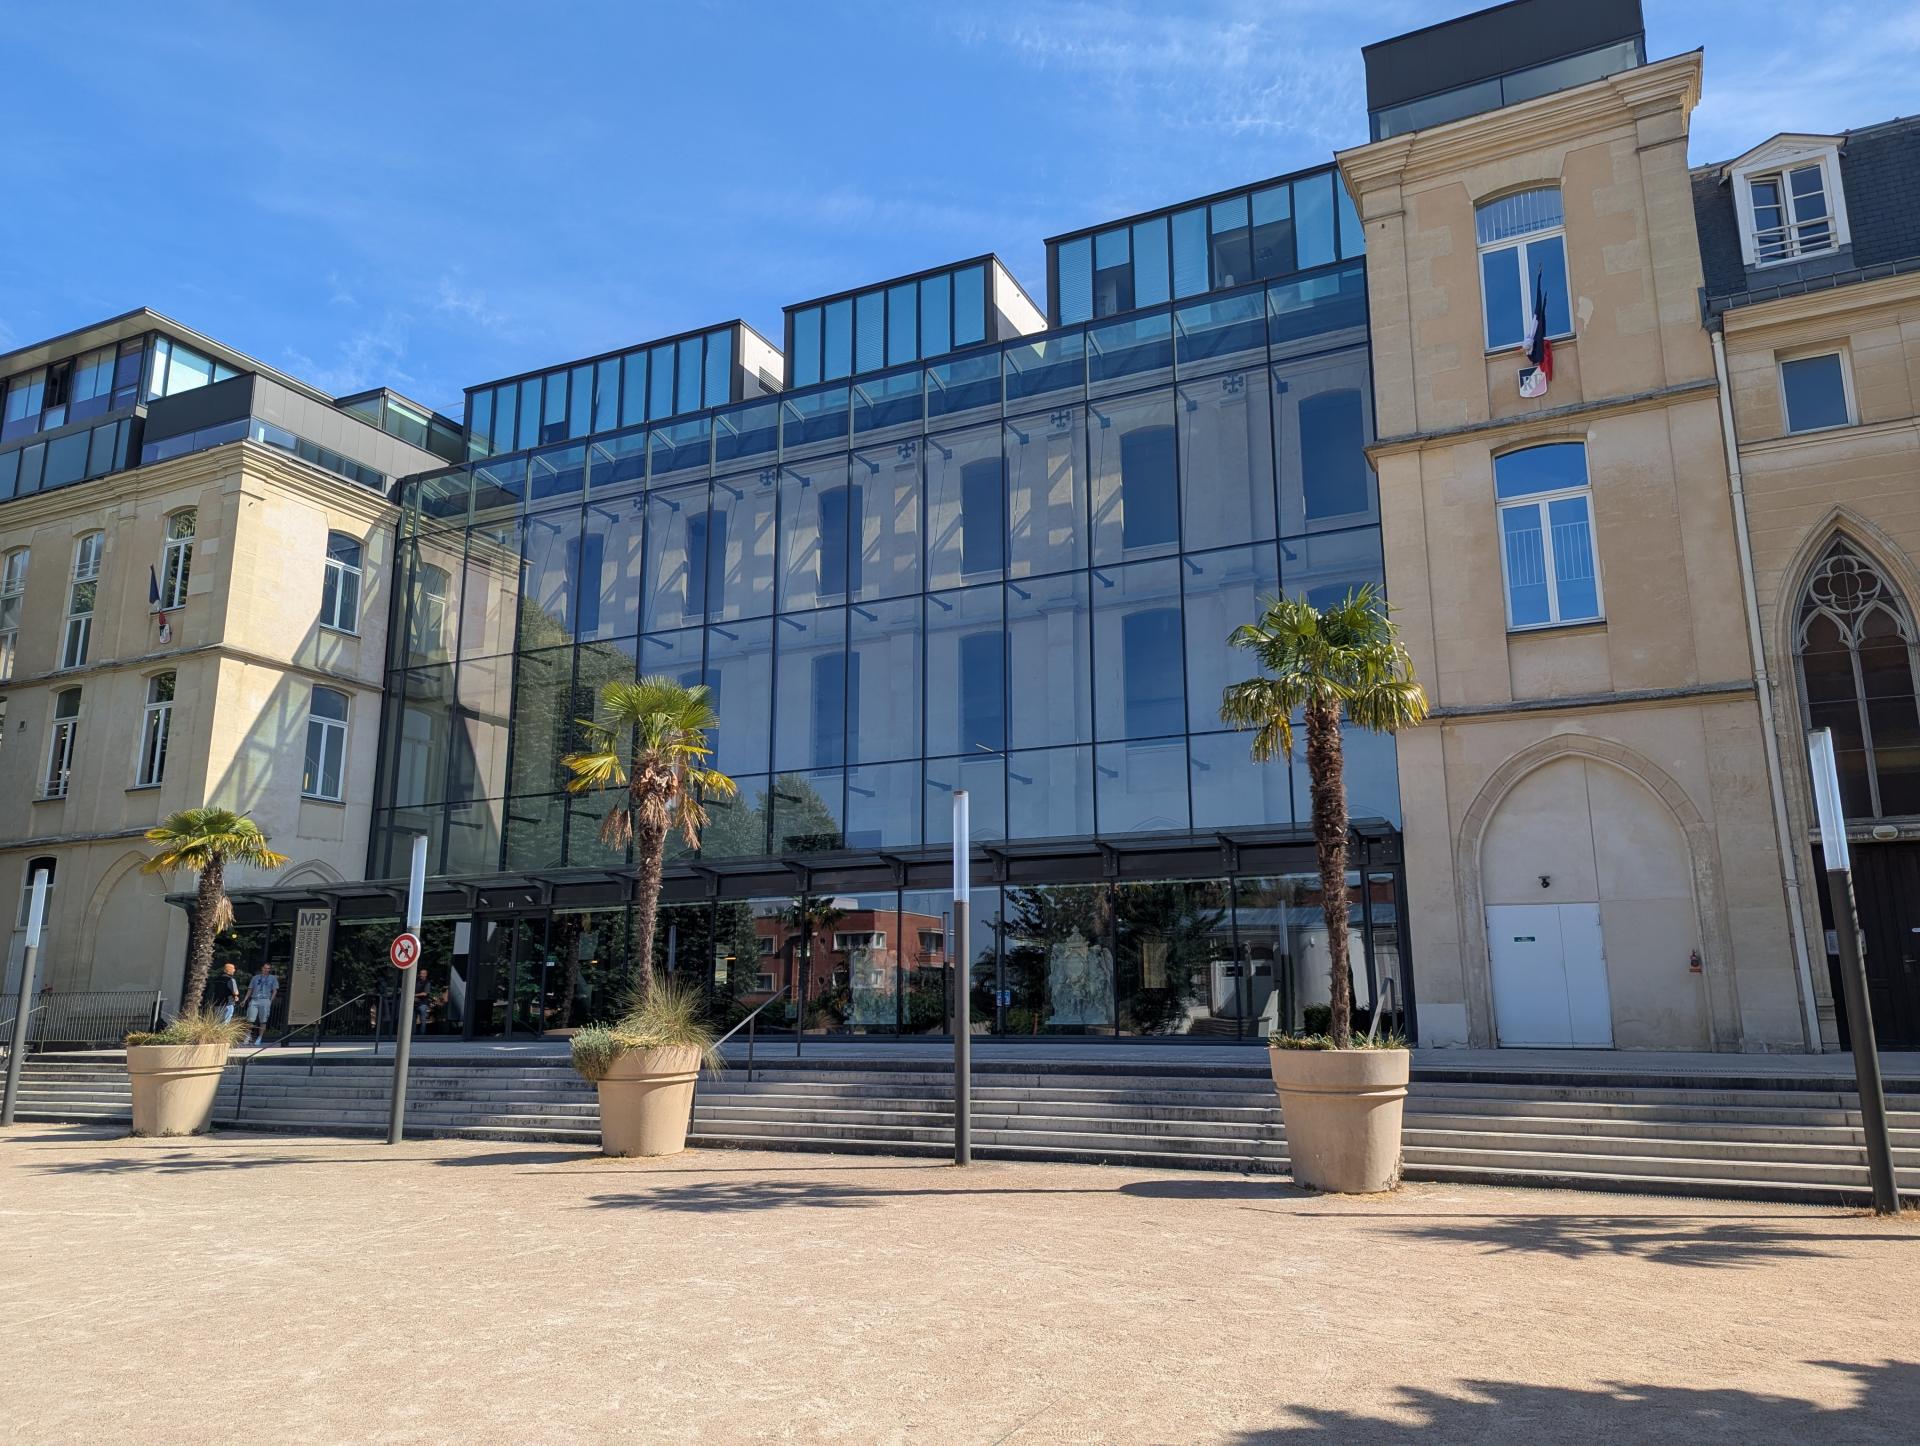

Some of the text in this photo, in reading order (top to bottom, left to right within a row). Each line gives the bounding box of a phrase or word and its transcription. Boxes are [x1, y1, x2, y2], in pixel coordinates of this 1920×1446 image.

[300, 912, 327, 926] MPP
[296, 927, 306, 971] MÉDIATHÈQUE
[304, 927, 313, 965] PATRIMOINE
[310, 927, 320, 974] PHOTOGRAPHIE
